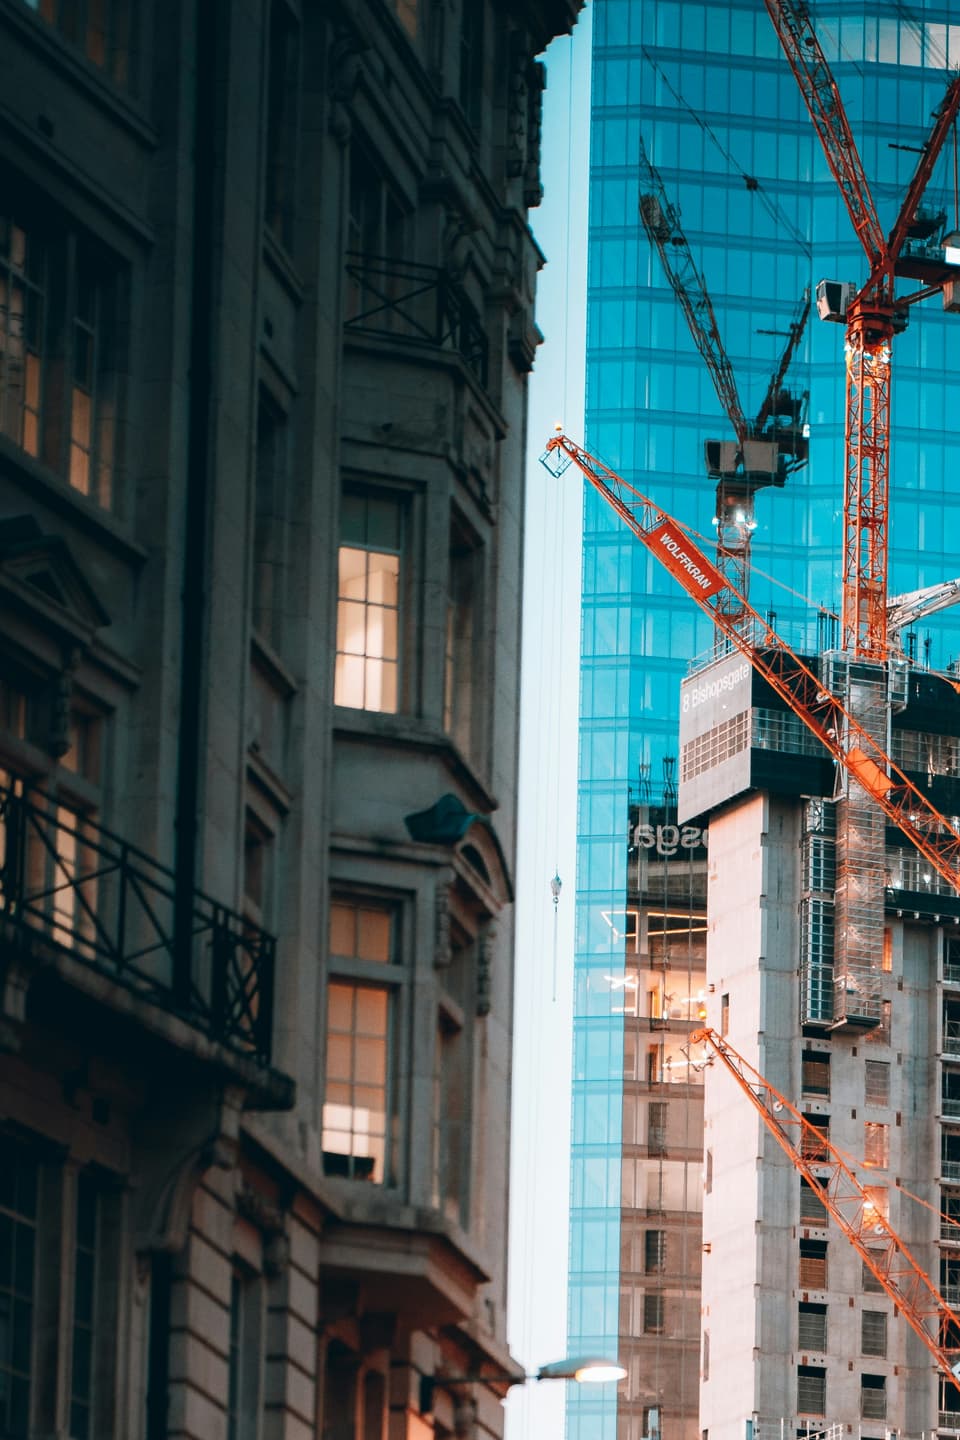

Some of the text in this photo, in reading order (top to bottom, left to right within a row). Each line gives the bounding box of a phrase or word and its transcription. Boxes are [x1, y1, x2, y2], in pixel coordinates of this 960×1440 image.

[779, 0, 801, 40] OLFF
[660, 533, 712, 589] WOLFFKRAN
[683, 664, 750, 712] 8 Bishopsgate
